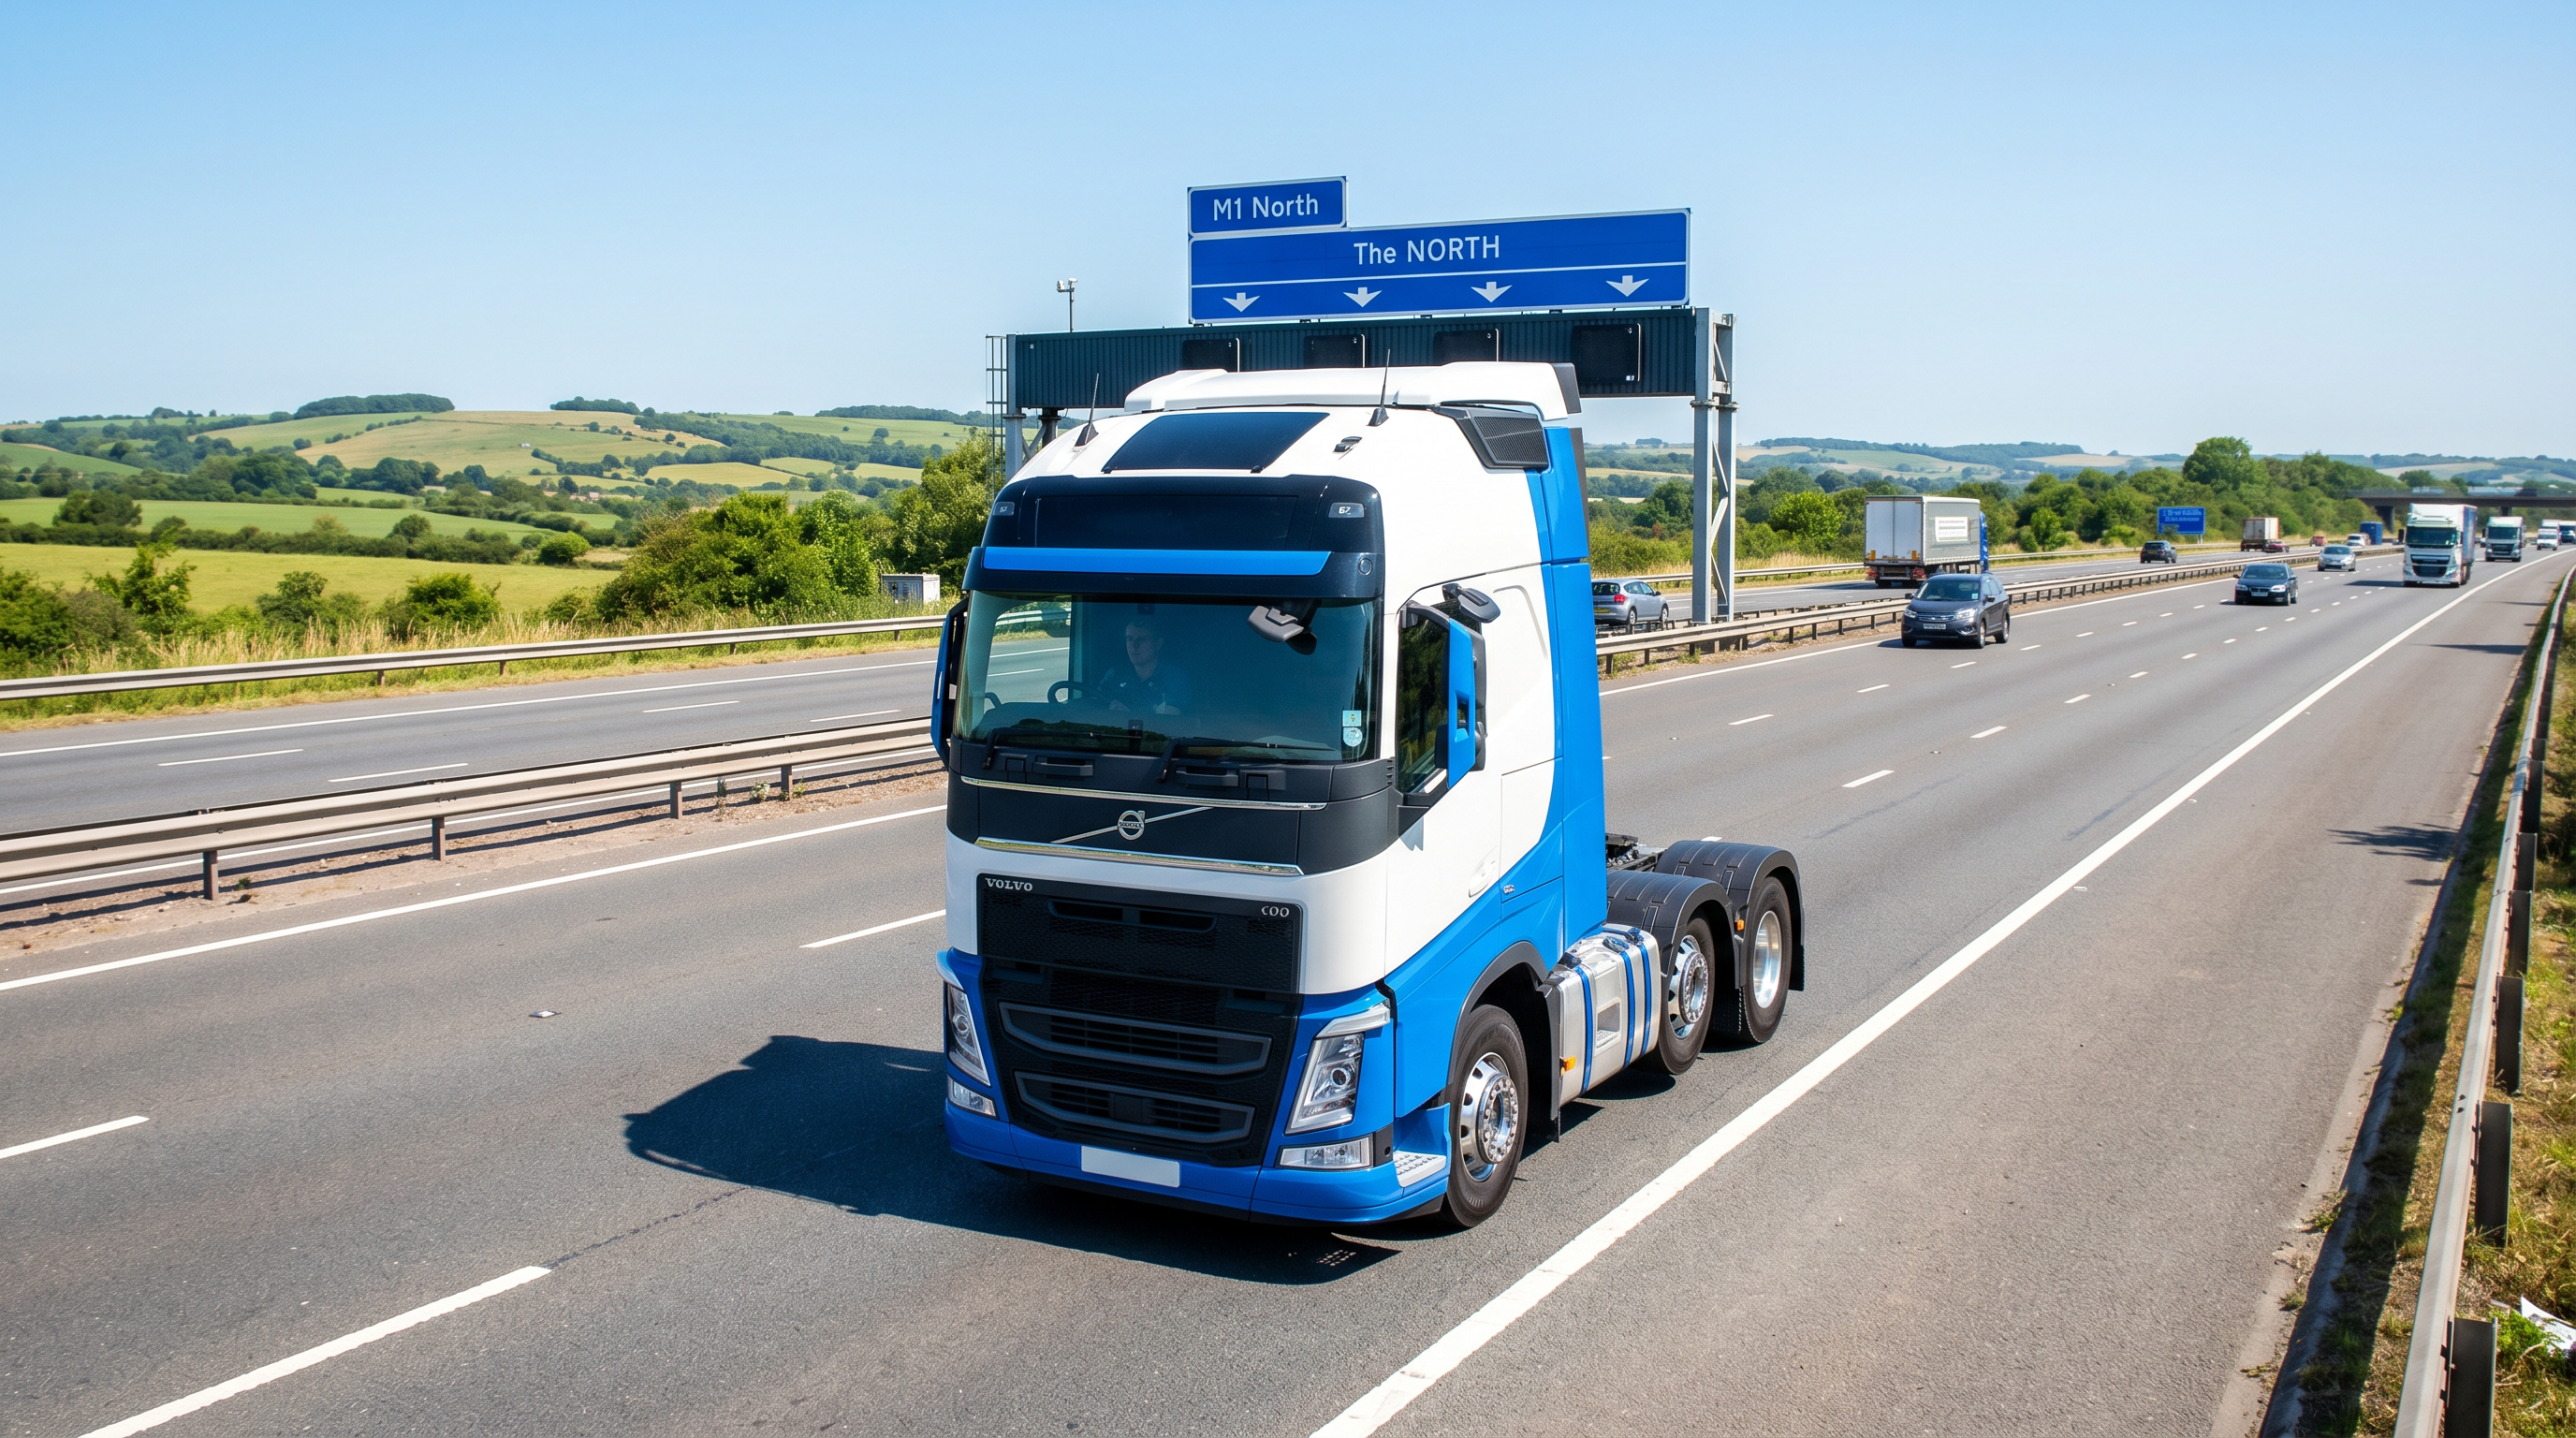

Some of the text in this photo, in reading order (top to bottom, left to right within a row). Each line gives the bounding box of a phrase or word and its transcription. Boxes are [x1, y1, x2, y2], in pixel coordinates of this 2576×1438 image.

[1213, 193, 1319, 221] M1 North
[1354, 235, 1500, 265] The NORTH
[985, 877, 1033, 892] VOLVO
